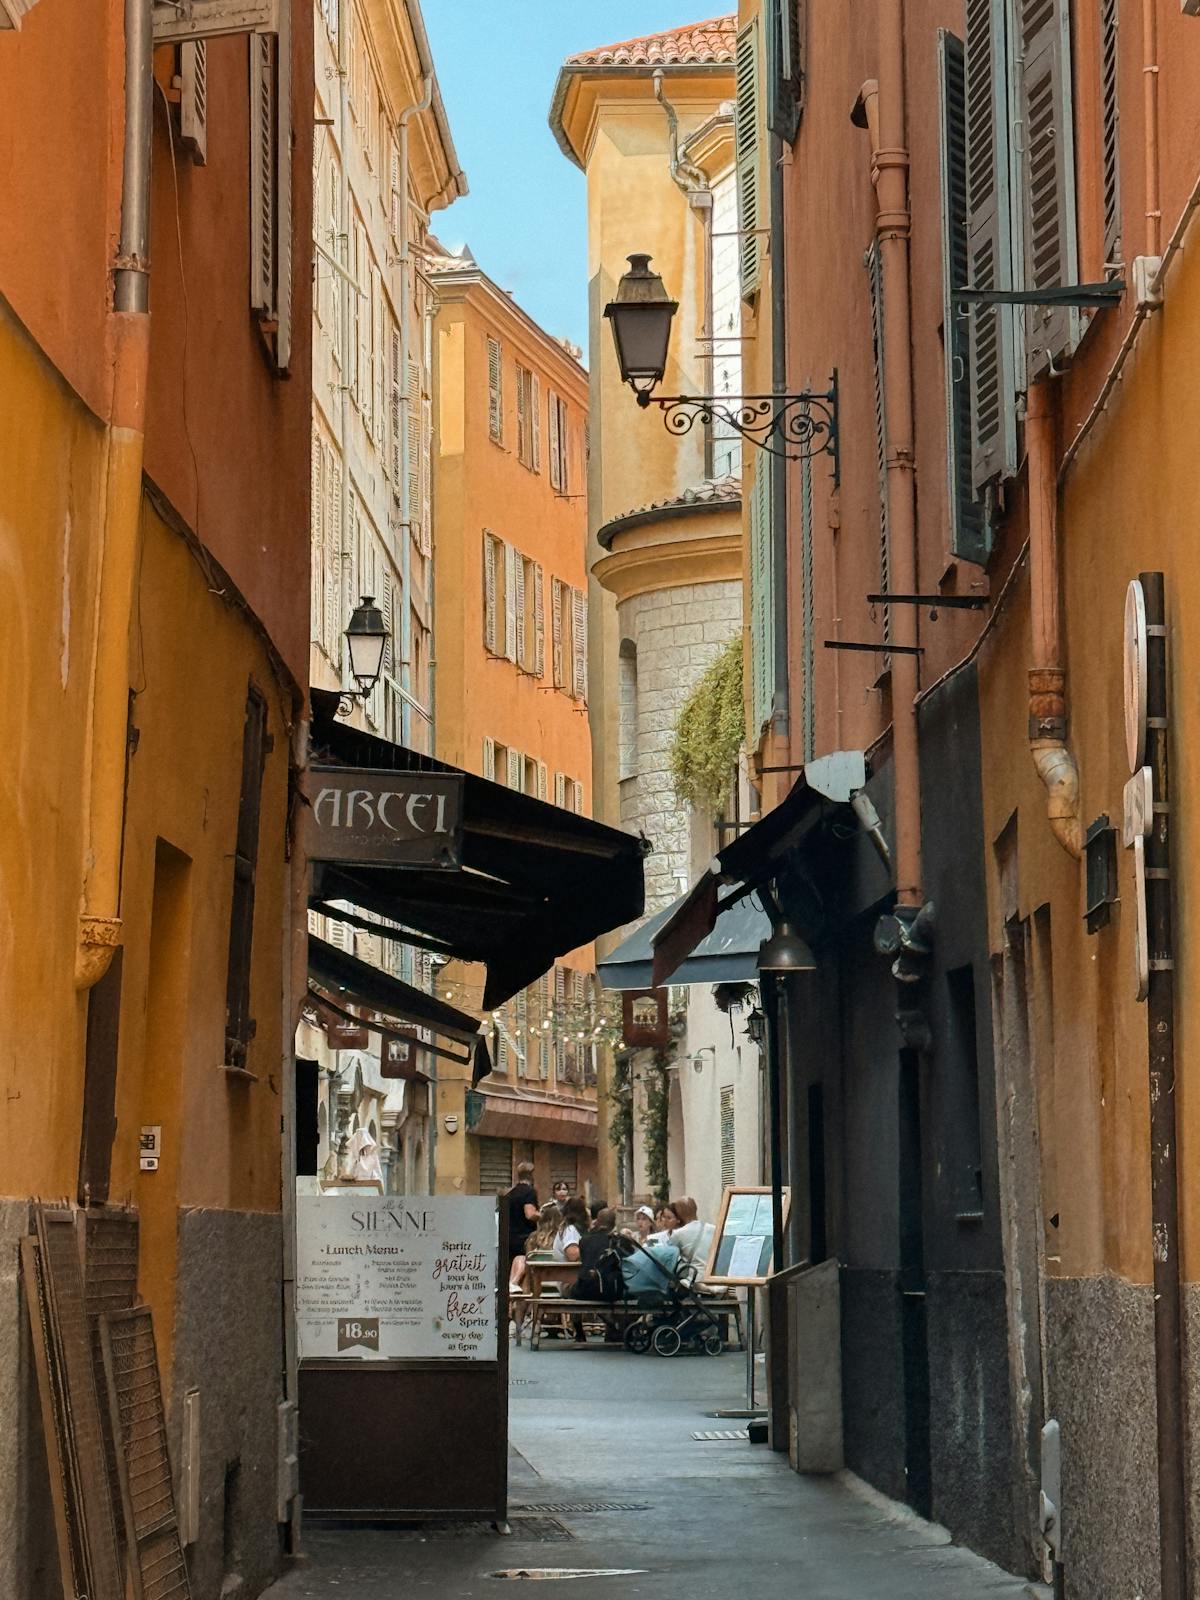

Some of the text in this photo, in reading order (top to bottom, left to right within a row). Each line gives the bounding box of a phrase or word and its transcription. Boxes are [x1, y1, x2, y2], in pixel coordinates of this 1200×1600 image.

[351, 1211, 437, 1232] SIENNE
[326, 1244, 399, 1255] Lunch Menu
[446, 1291, 479, 1322] free
[459, 1317, 489, 1328] Spritz
